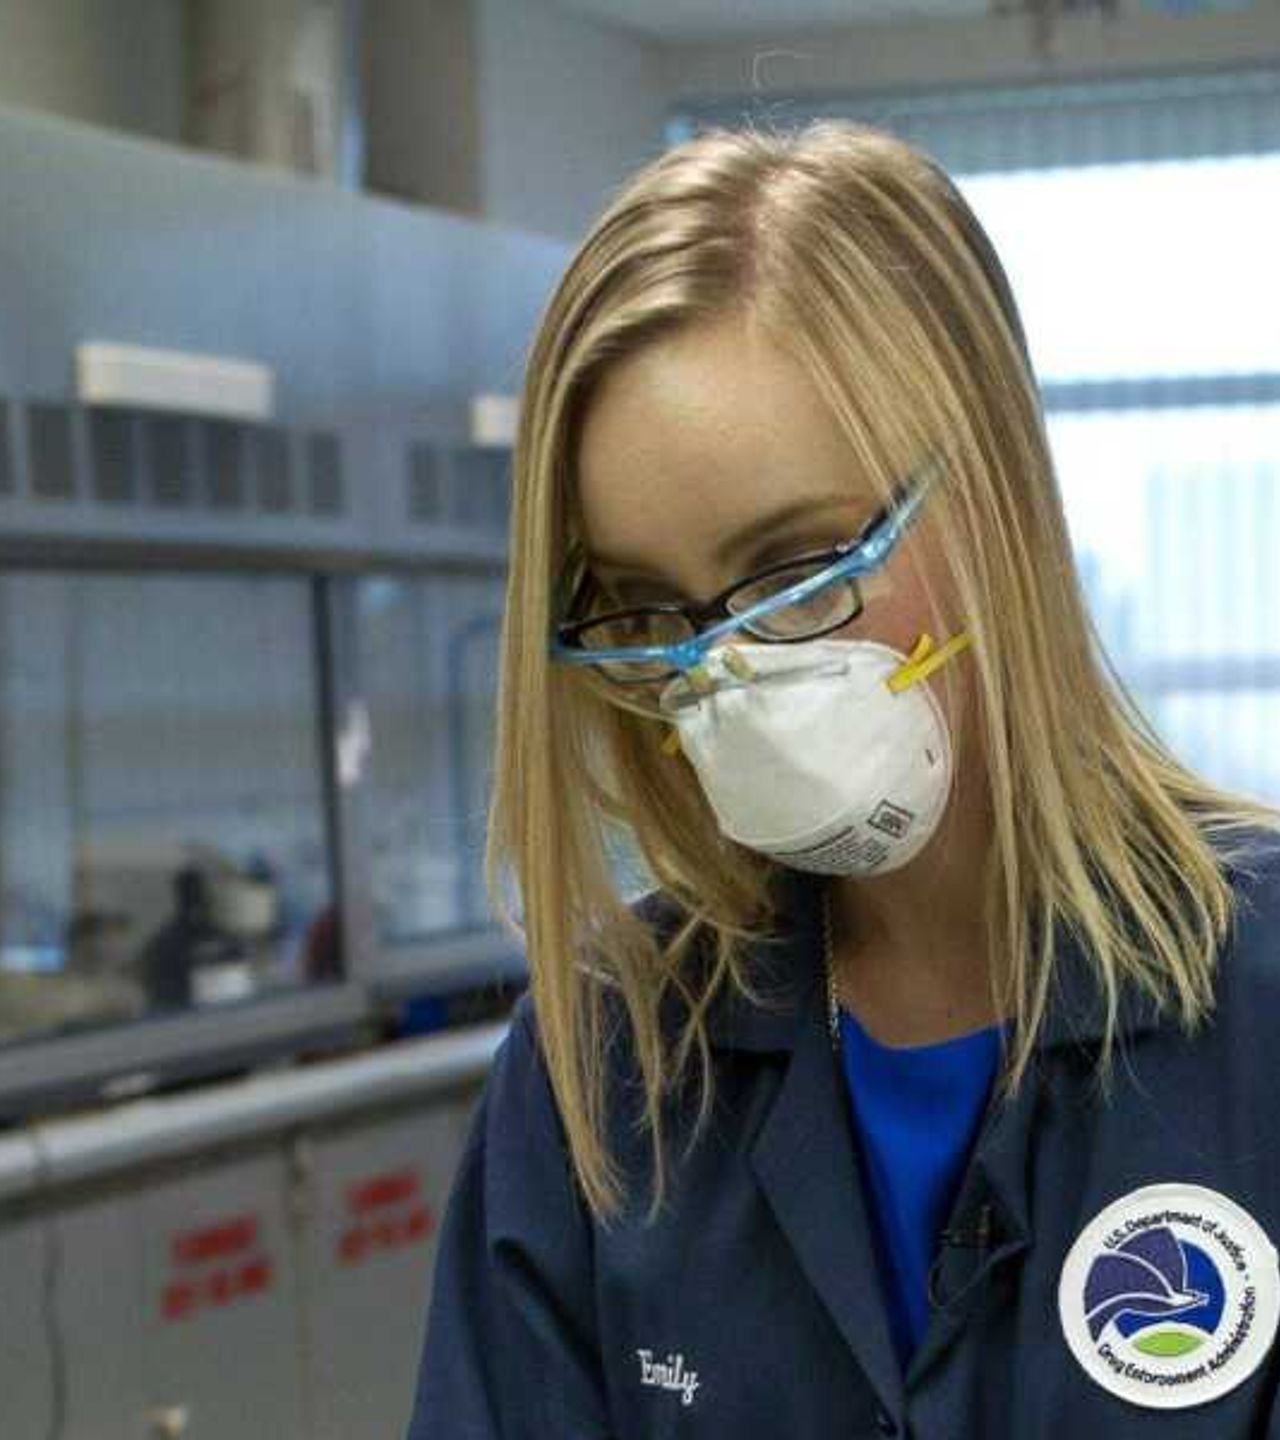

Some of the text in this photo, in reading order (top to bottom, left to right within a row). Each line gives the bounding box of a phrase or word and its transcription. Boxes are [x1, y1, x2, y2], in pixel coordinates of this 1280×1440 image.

[1103, 1211, 1247, 1271] U.S. Department of Justice
[1098, 1286, 1256, 1386] Drug Enforcement Administration
[636, 1348, 701, 1406] Emily
